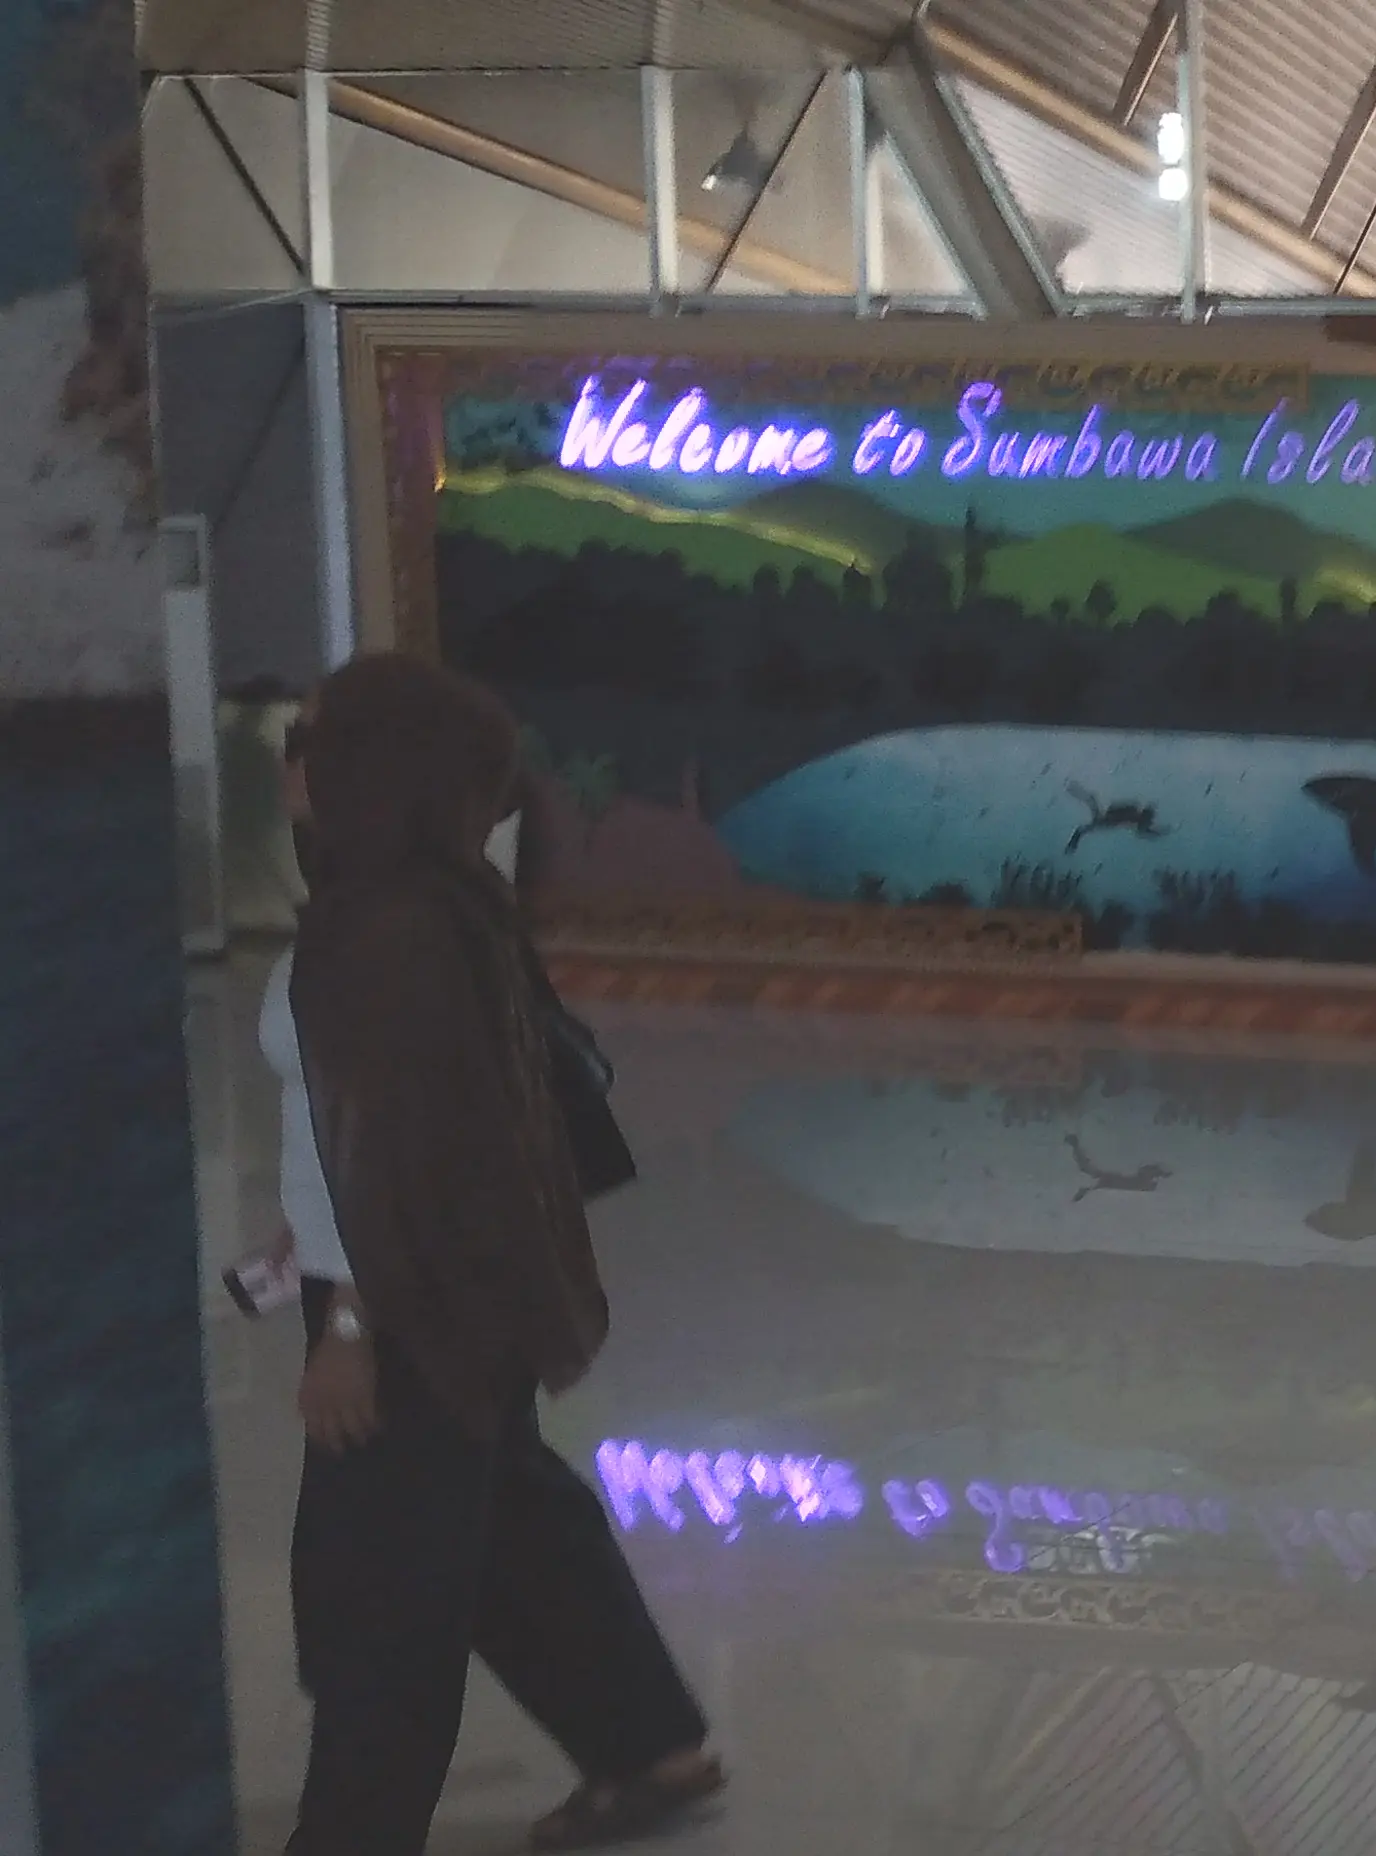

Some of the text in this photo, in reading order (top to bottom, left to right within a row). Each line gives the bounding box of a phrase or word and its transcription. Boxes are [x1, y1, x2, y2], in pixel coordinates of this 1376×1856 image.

[559, 374, 834, 479] Welcome
[852, 408, 928, 478] to
[940, 381, 1217, 484] Sumbawa
